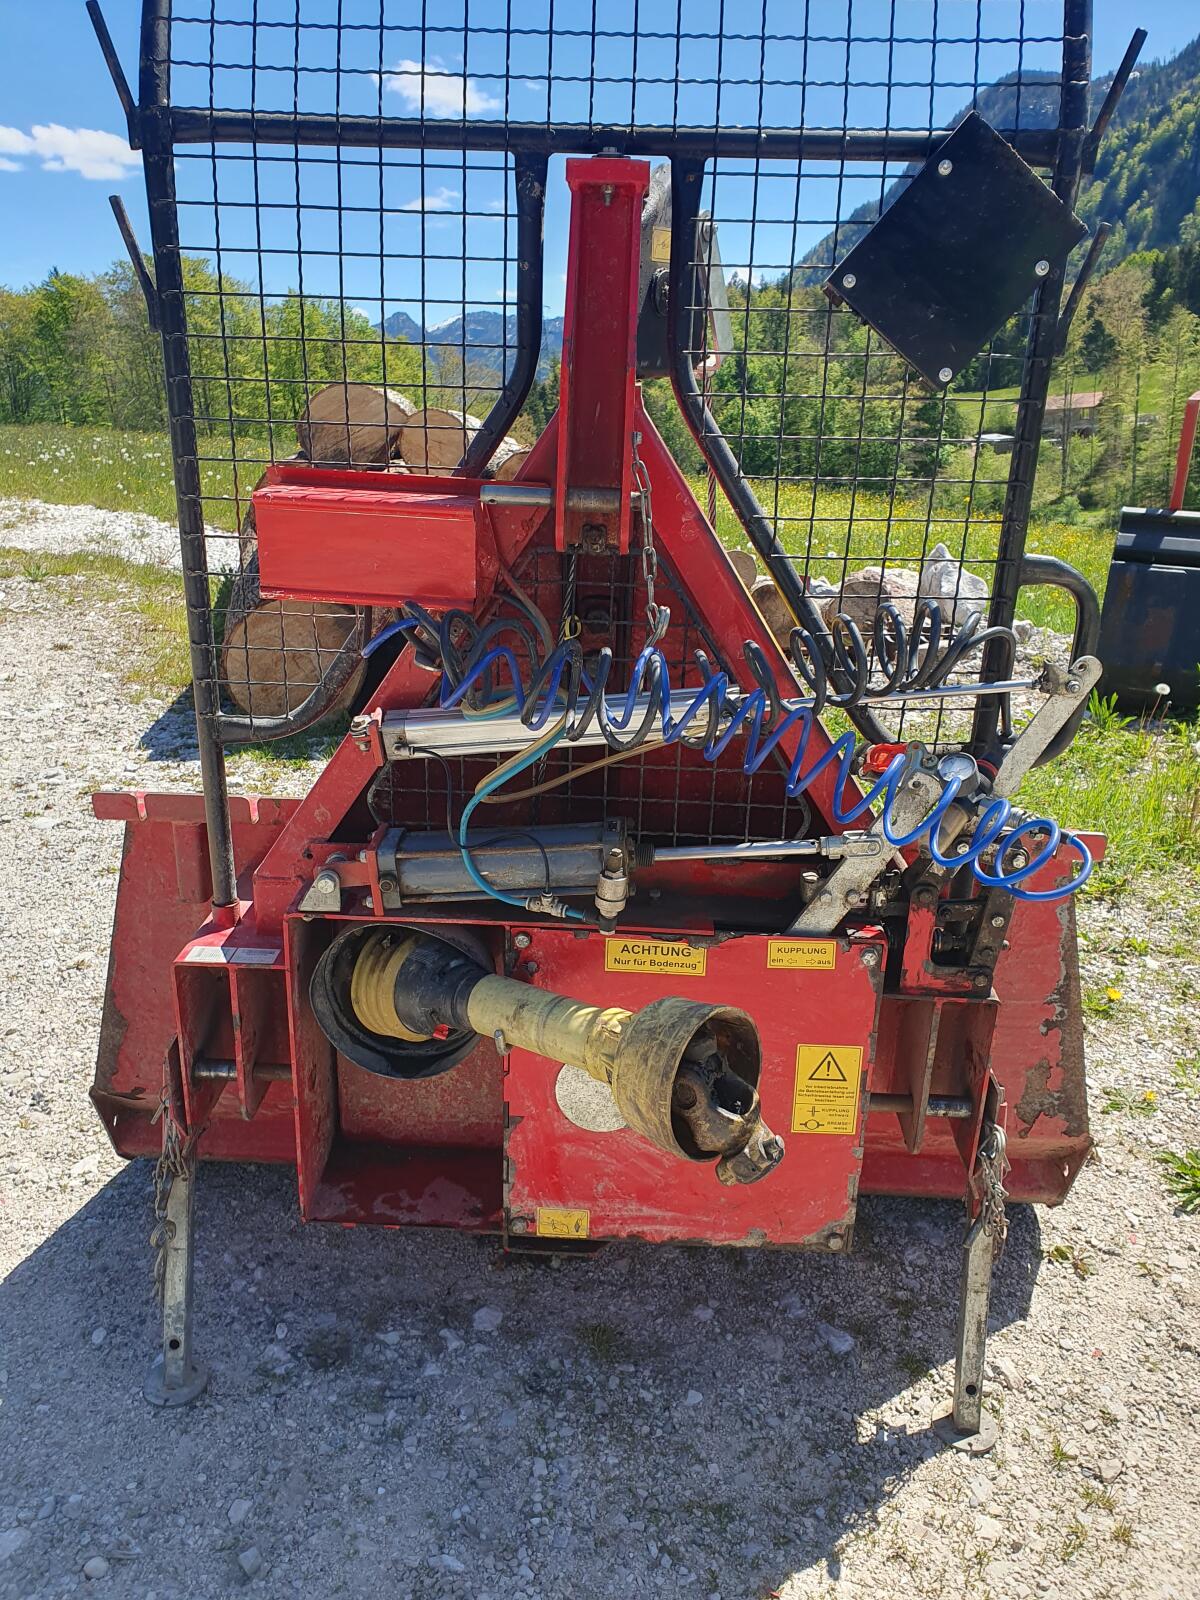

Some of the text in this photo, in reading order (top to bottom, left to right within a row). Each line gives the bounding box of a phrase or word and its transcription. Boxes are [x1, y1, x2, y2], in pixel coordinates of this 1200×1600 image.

[620, 943, 692, 957] ACHTUNG
[776, 947, 827, 955] KUPPLUNG
[613, 957, 697, 970] Nur für Bodenzug
